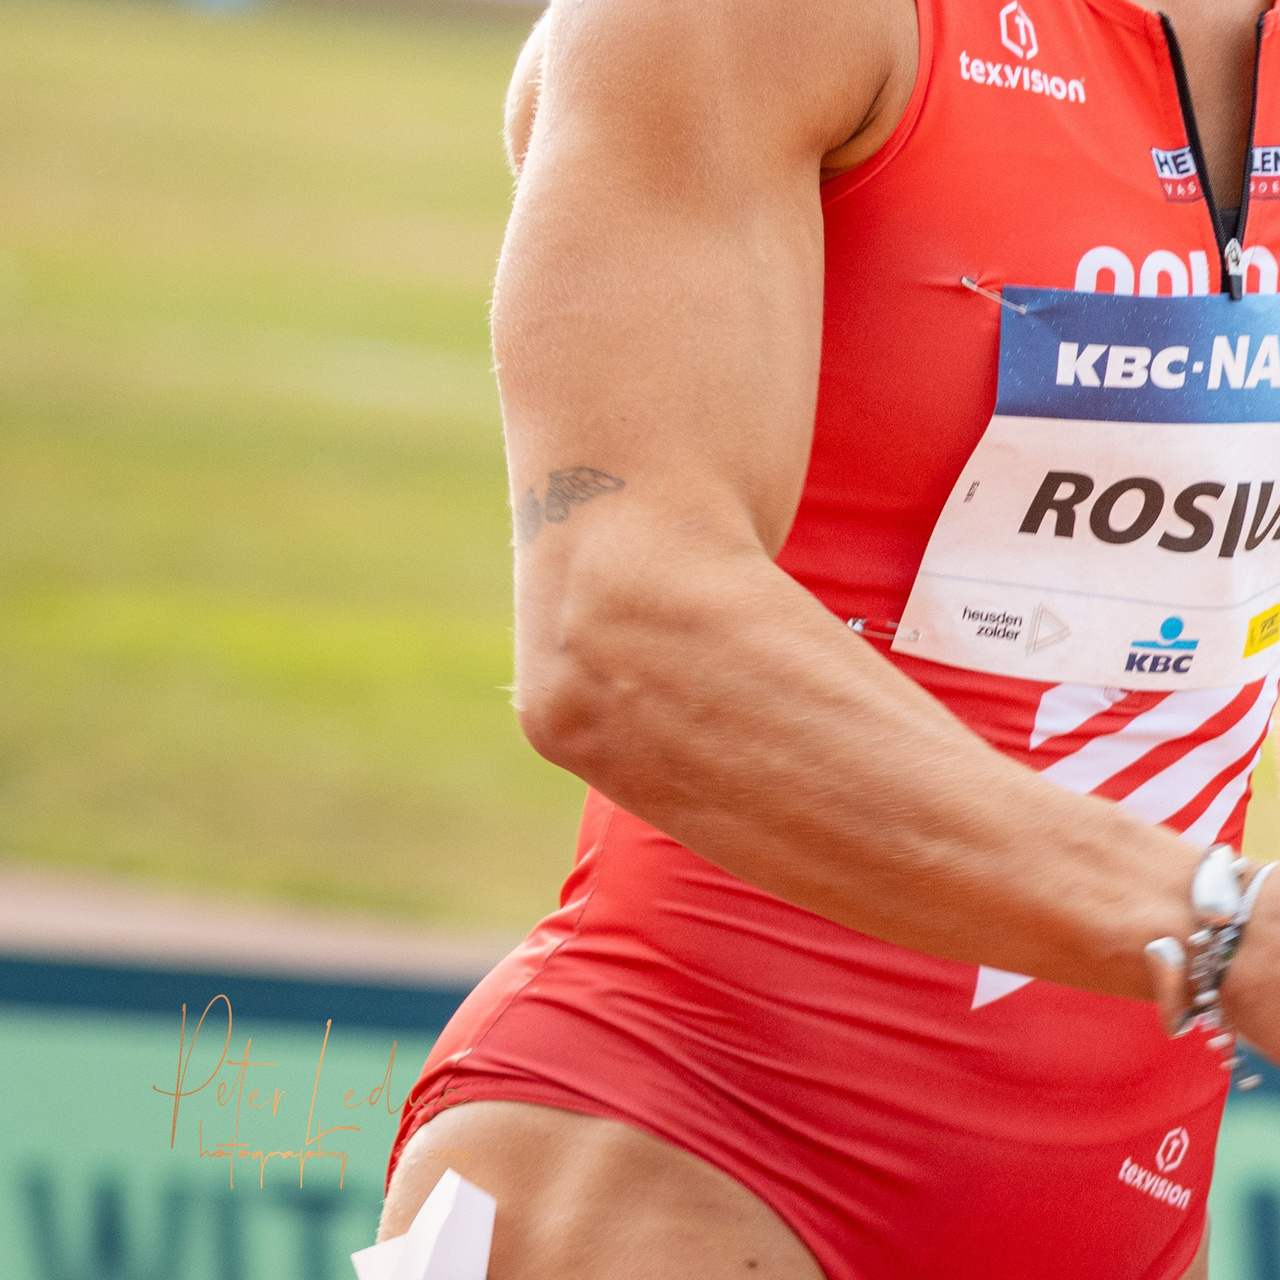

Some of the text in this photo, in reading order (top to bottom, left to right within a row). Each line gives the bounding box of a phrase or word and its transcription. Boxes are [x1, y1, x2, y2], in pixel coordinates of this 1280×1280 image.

[962, 605, 1023, 627] heusden
[976, 622, 1021, 641] zolder
[1125, 653, 1194, 674] KBC
